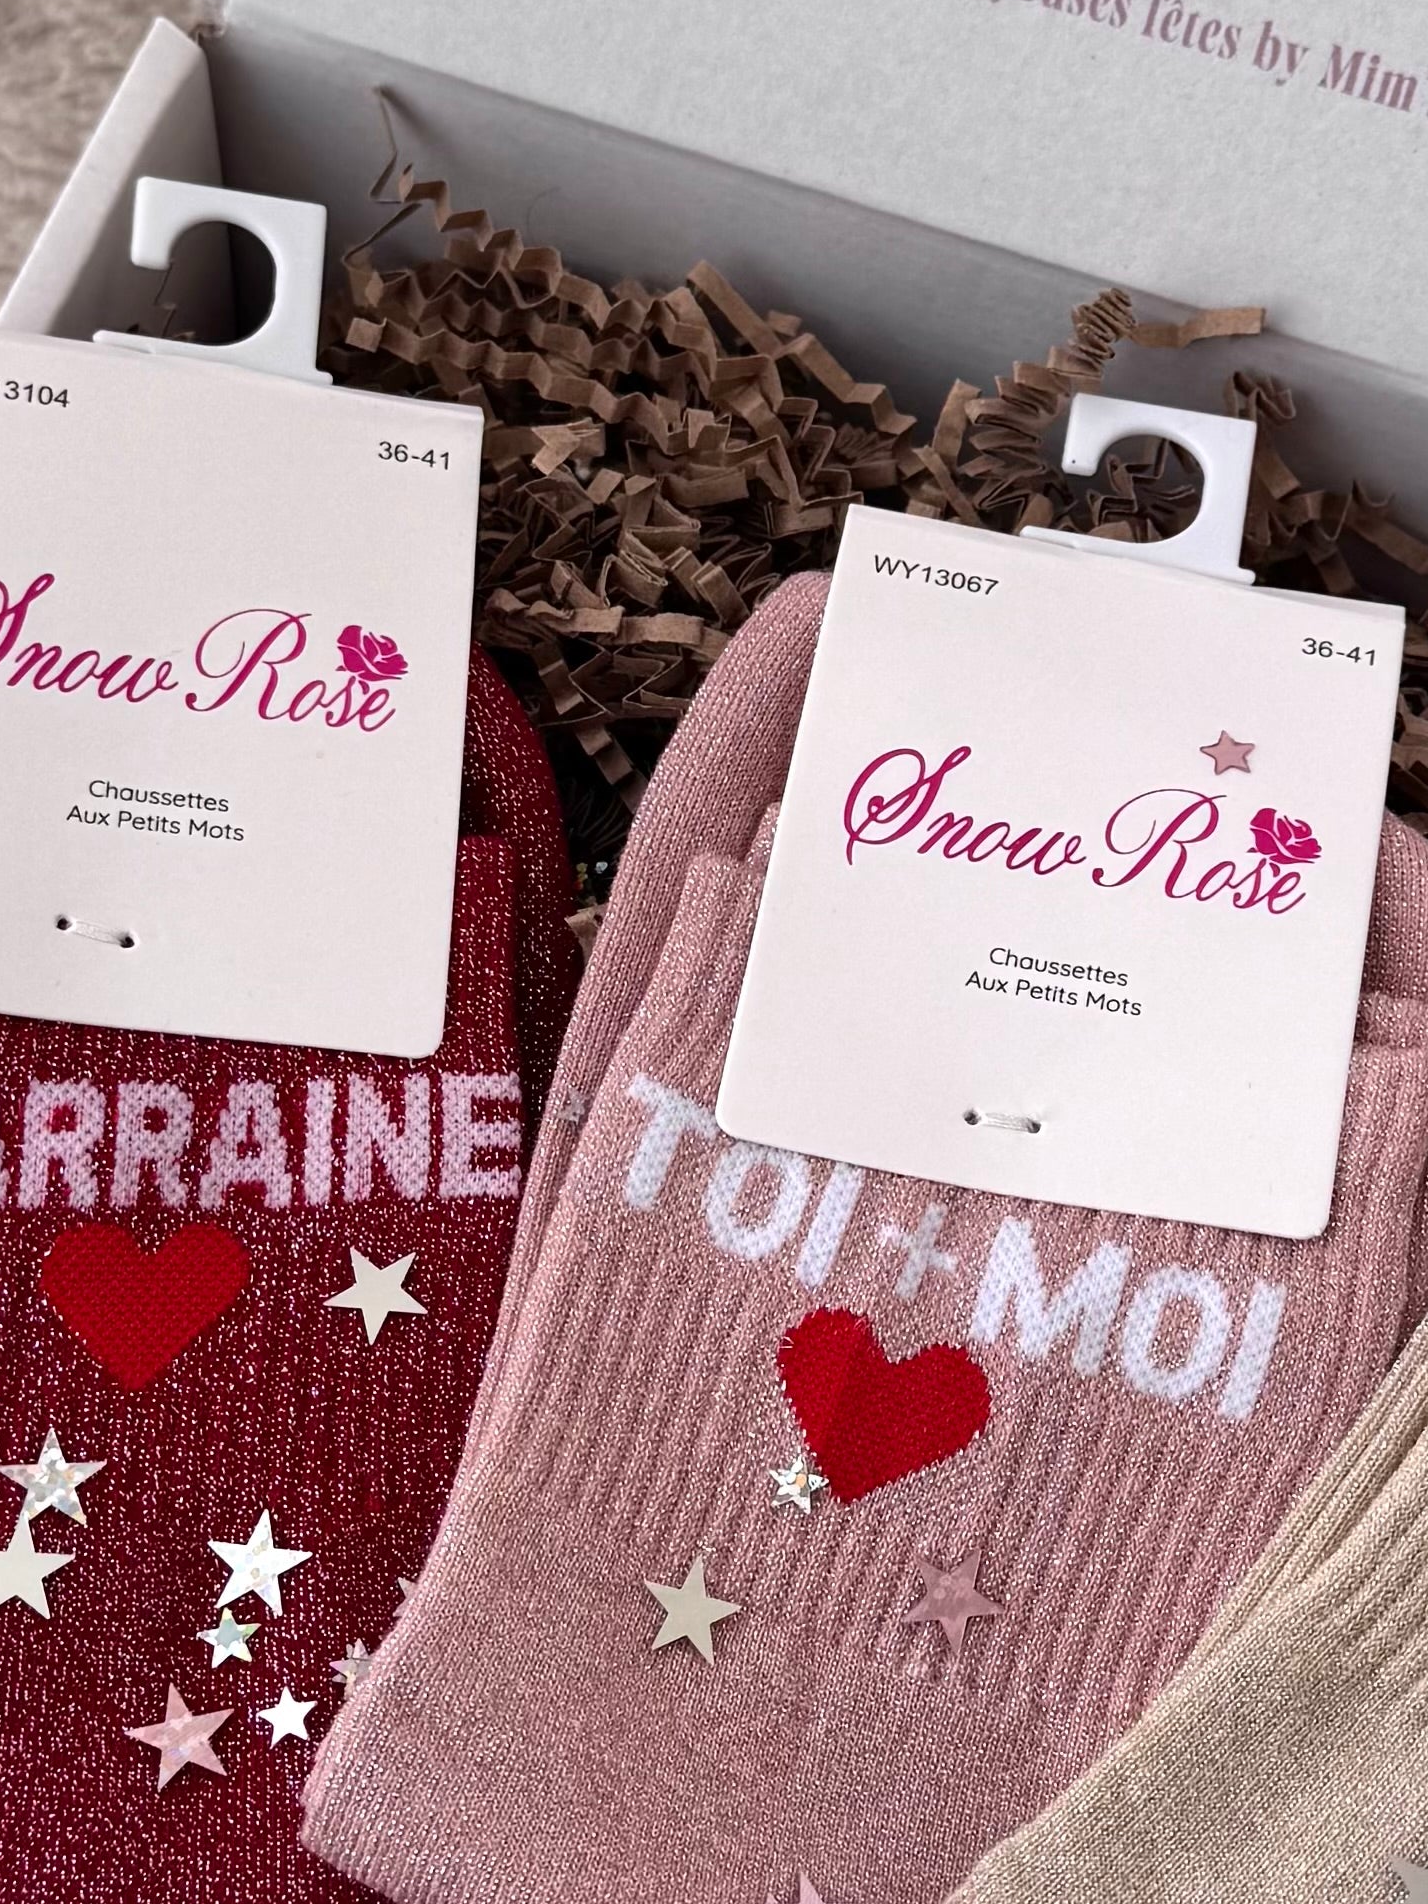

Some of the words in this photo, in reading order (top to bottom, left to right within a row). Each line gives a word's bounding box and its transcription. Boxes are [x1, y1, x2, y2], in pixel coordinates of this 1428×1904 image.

[1254, 21, 1309, 86] by
[378, 440, 451, 471] 36-41
[874, 554, 999, 596] WY13067
[184, 608, 398, 732] Rose
[1301, 636, 1378, 666] 36-41
[87, 779, 229, 814] Chaussettes
[66, 806, 110, 828] Aux
[117, 810, 182, 836] Petits
[188, 818, 244, 842] Mots
[843, 746, 1085, 876] Snow
[1092, 788, 1309, 916] Rose
[987, 947, 1128, 988] Chaussettes
[964, 971, 1009, 996] Aux
[1015, 978, 1078, 1007] Petits
[1085, 990, 1142, 1016] Mots
[625, 1072, 866, 1289] TOI
[971, 1217, 1286, 1422] MOI
